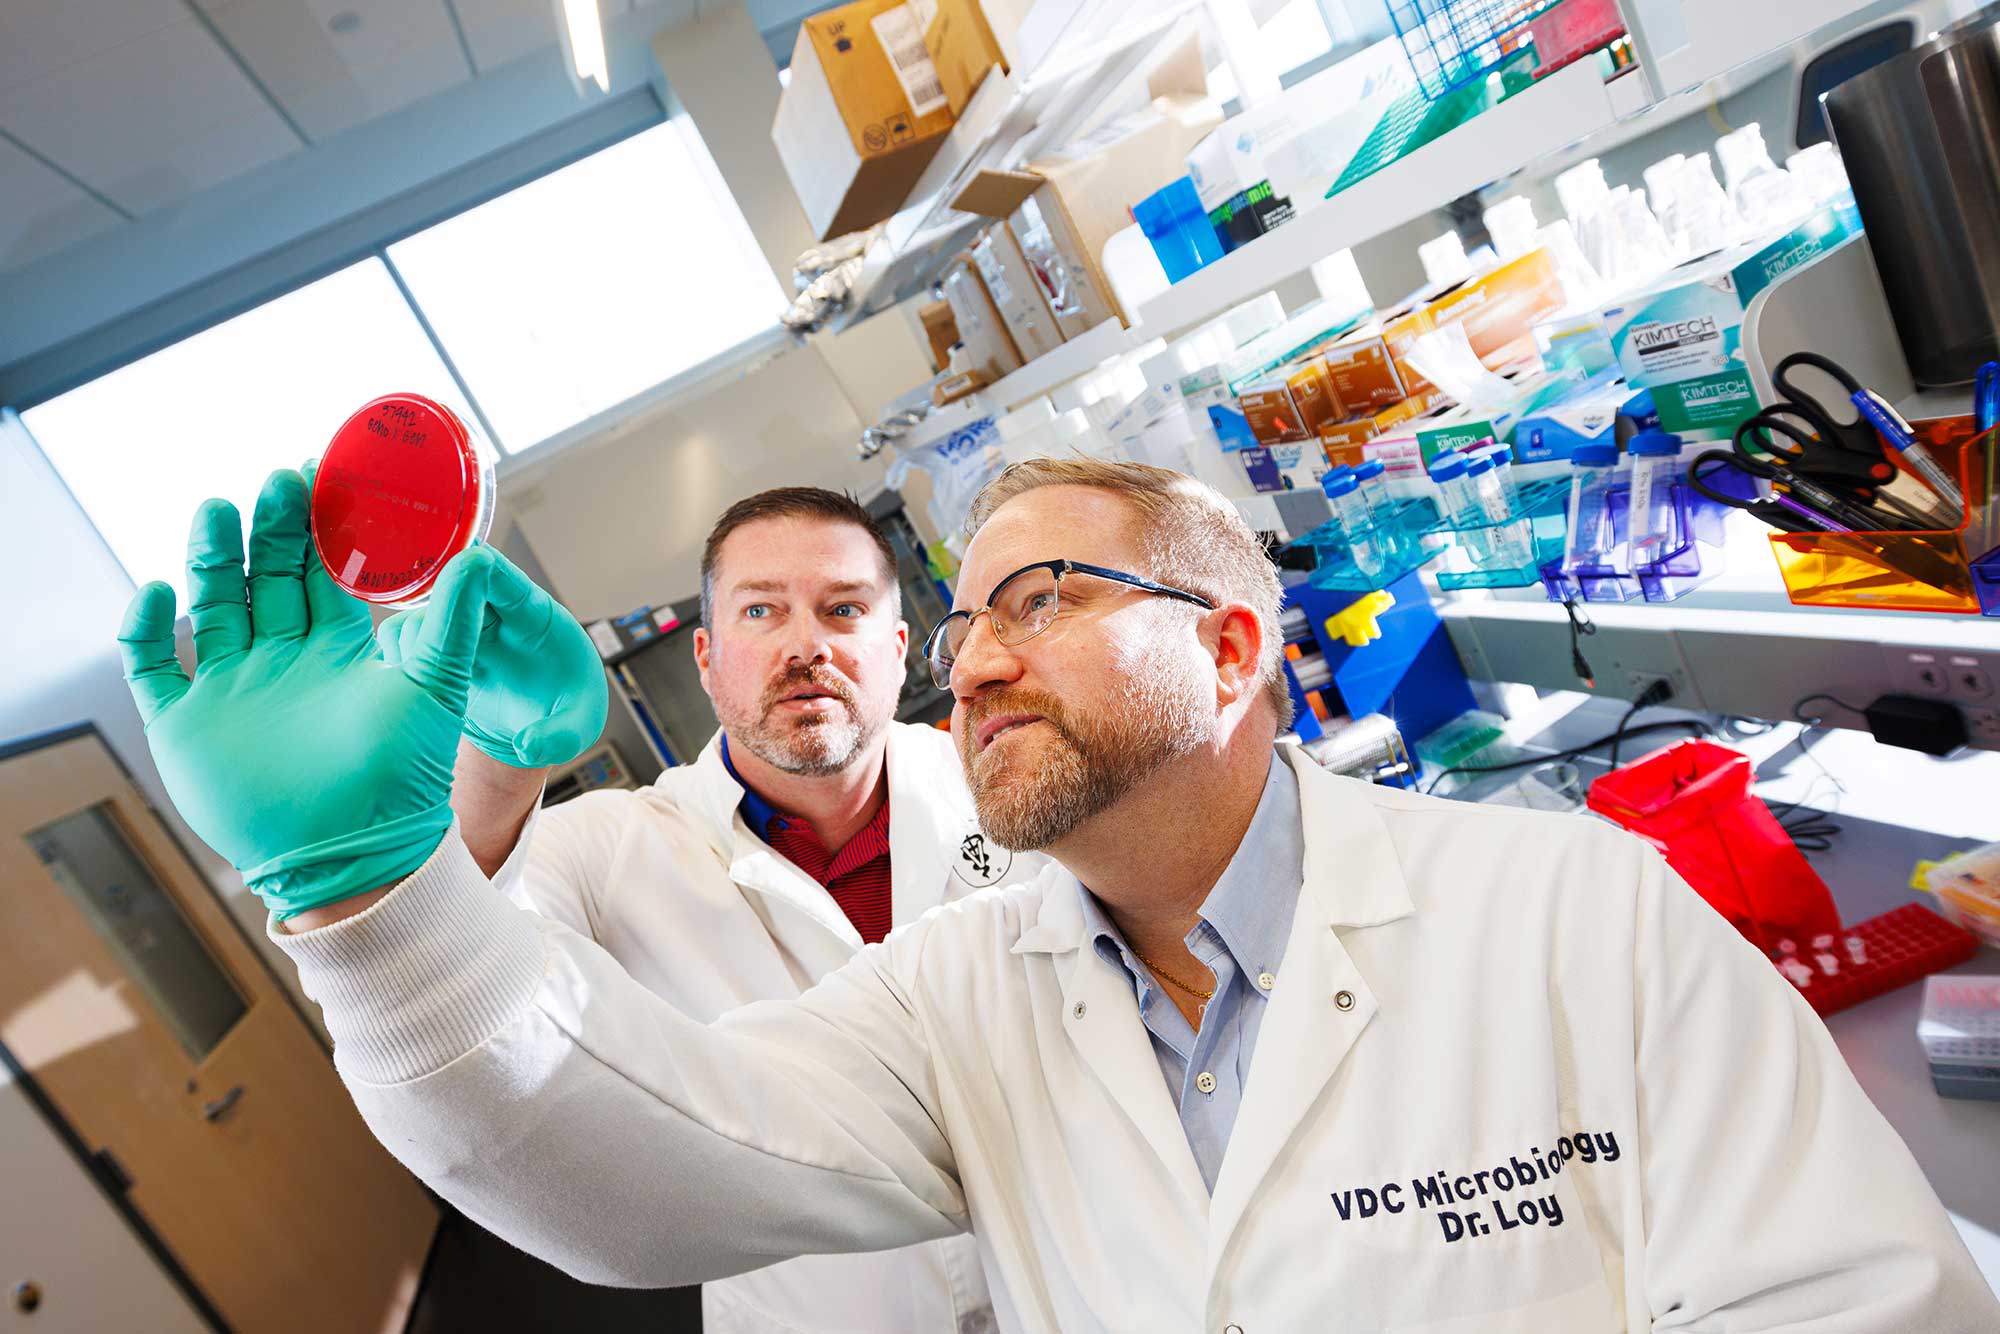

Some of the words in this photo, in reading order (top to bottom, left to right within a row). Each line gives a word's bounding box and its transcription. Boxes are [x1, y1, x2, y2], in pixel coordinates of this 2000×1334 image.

[827, 21, 845, 36] UP
[1765, 239, 1823, 280] KIMTECH
[1633, 315, 1717, 349] KIMTECH
[1681, 379, 1749, 401] KIMTECH
[1437, 434, 1478, 449] KIMTECH
[1331, 1182, 1405, 1221] VDC
[1412, 1131, 1621, 1209] Microbioogy
[1438, 1210, 1491, 1243] Dr.
[1492, 1193, 1564, 1231] Loy
